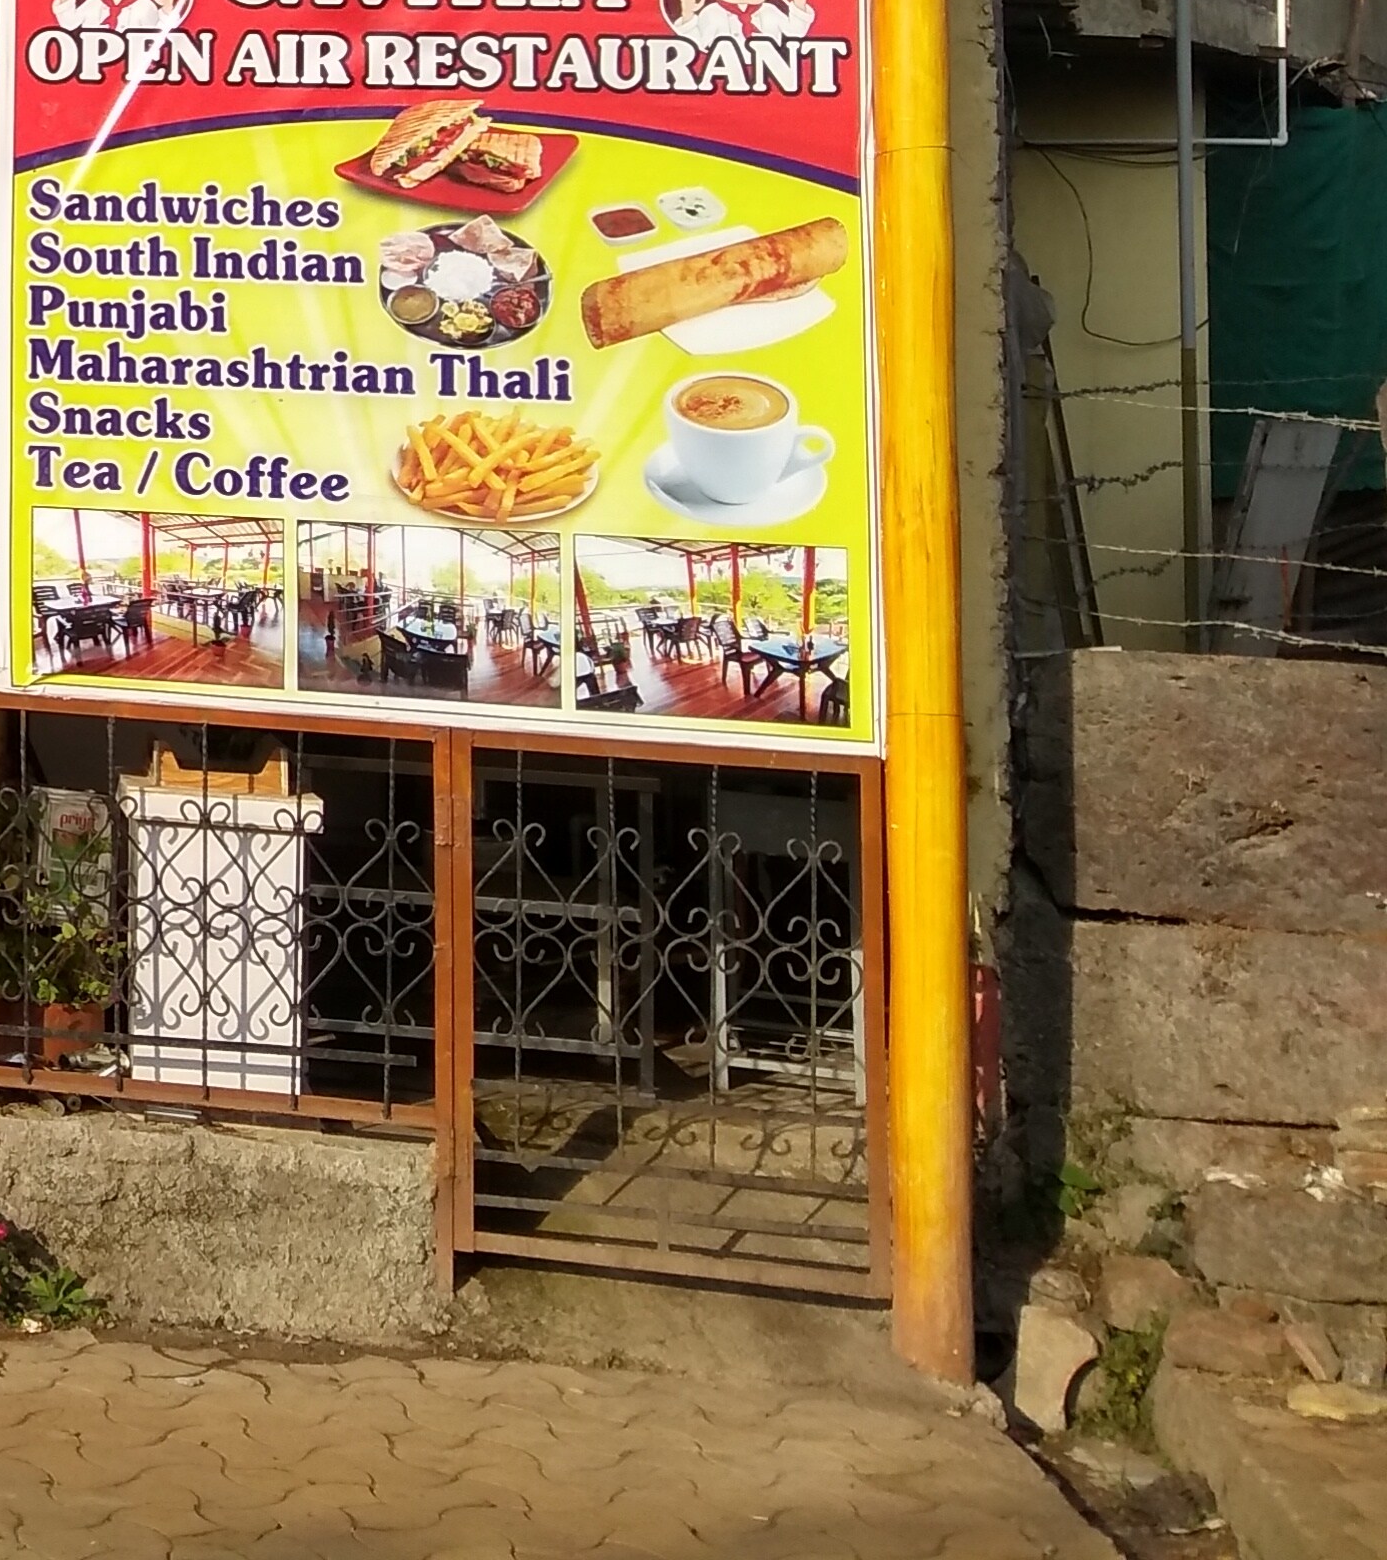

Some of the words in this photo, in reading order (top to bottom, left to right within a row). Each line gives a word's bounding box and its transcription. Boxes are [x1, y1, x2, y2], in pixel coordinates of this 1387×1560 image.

[27, 30, 215, 82] OPEN
[227, 34, 351, 86] AIR
[365, 34, 847, 94] RESTAURANT
[28, 178, 341, 228] Sandwiches
[28, 231, 180, 275] South
[192, 236, 365, 284] Indian
[28, 284, 228, 340] Punjabi
[27, 338, 417, 395] Maharashtrian
[429, 353, 573, 402] Thali
[27, 391, 211, 440] Snacks
[27, 445, 123, 491] Tea
[137, 450, 159, 495] /
[176, 451, 351, 502] Coffee
